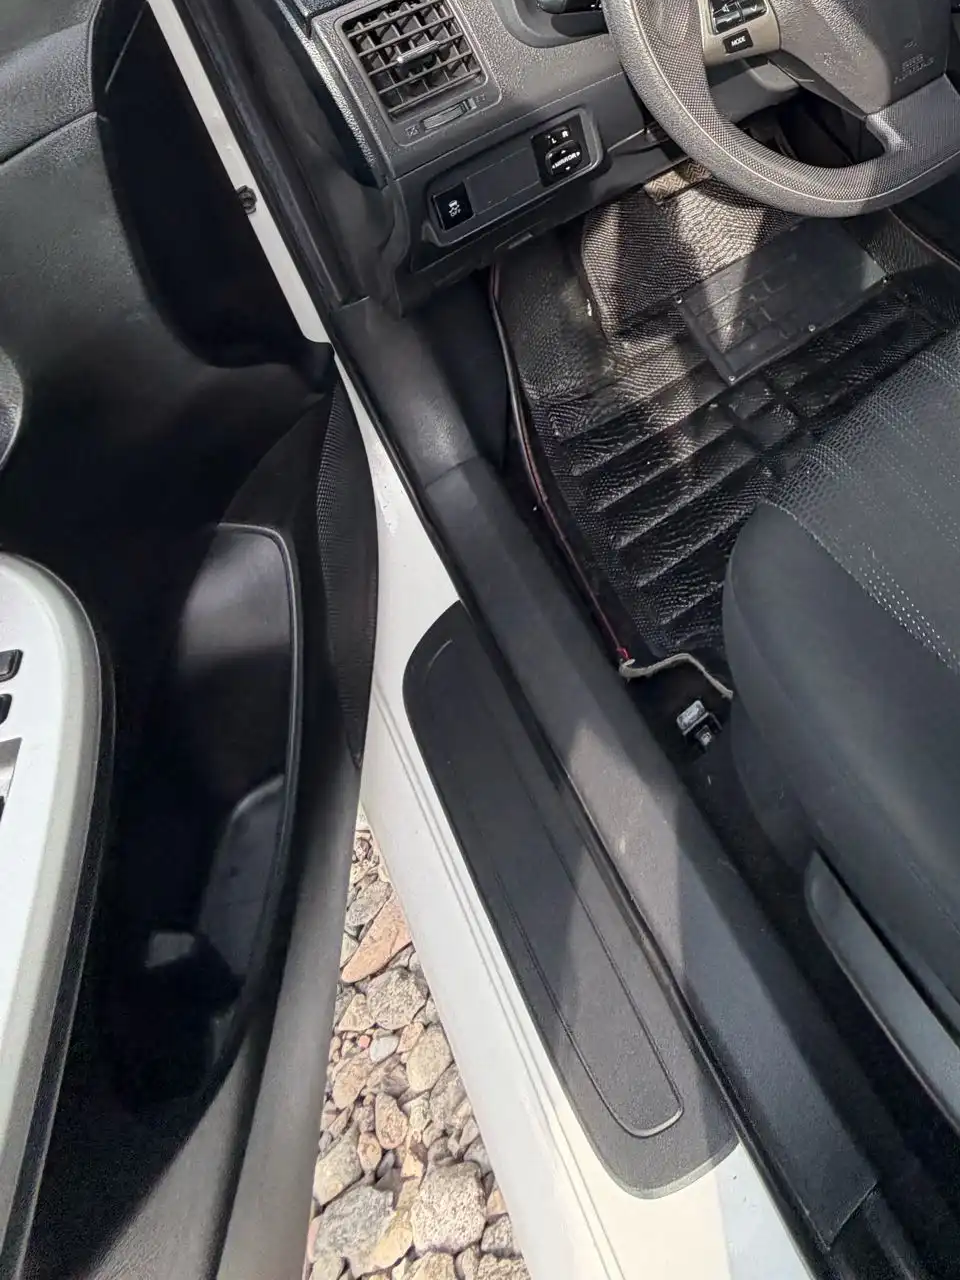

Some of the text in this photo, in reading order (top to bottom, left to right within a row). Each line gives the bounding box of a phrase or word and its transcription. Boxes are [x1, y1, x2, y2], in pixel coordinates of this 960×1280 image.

[730, 35, 746, 47] MODE
[562, 130, 569, 138] R
[554, 152, 577, 168] MIRROR
